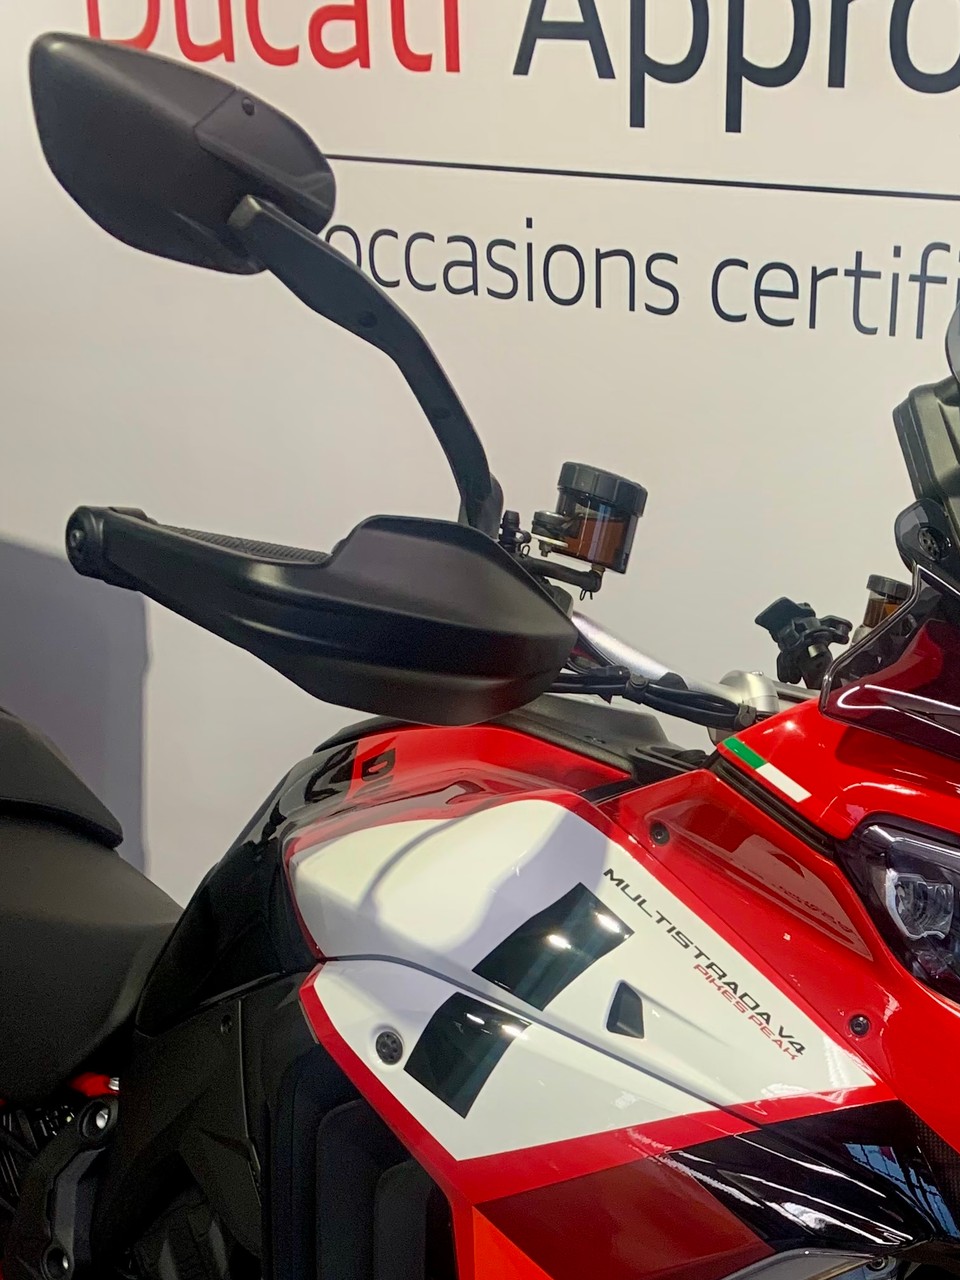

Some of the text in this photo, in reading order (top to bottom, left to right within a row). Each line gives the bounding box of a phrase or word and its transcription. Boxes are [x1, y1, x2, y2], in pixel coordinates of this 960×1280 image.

[324, 217, 680, 316] occasions
[603, 867, 772, 1026] MULTISTRADA
[778, 1025, 806, 1055] V4
[693, 964, 798, 1060] PIKES PEAK
